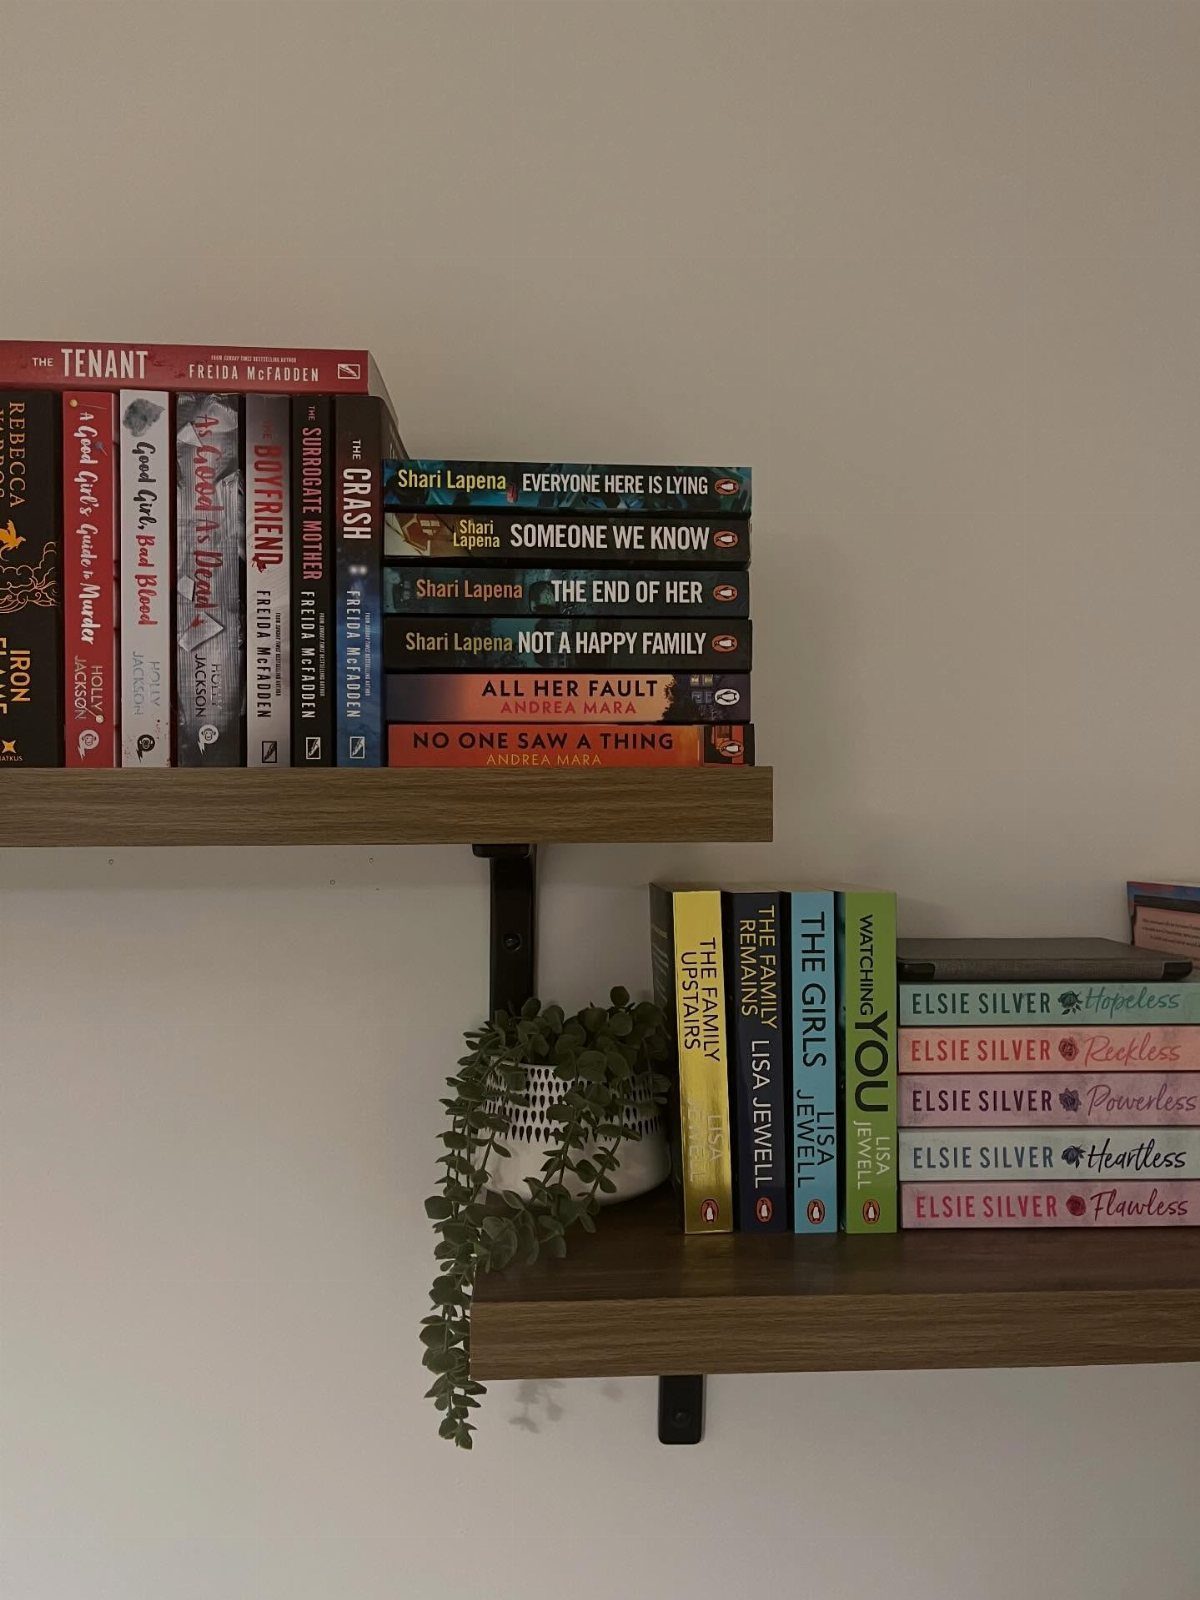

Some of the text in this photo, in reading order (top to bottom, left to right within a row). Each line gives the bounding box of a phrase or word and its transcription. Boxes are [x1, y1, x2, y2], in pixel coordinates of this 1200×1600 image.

[32, 348, 148, 379] THE TENANT
[189, 364, 319, 382] FREIDA McFADDEN
[9, 402, 26, 508] REBECCA
[253, 419, 284, 567] THE BOYFRIEND
[302, 405, 323, 580] THE SURROGATE MOTHER
[342, 439, 372, 539] THE CRASH
[398, 469, 507, 493] Shari Lapena
[522, 473, 709, 495] EVERYONE HERE IS LYING
[73, 411, 101, 645] A Good Girl's Guide to Murder
[132, 441, 158, 626] Good Girl, Bad Blood
[193, 414, 225, 609] As Good As Dead
[459, 519, 494, 535] Shari
[453, 533, 500, 551] Lapena
[510, 524, 710, 551] SOMEONE WE KNOW
[416, 579, 523, 602] Shari Lapena
[551, 579, 703, 604] THE END OF HER
[256, 590, 272, 718] FREIDA McFADDEN
[300, 591, 316, 718] FREIDA McFADDEN
[346, 590, 361, 718] FREIDA McFADDEN
[405, 632, 513, 656] Shari Lapena
[518, 631, 707, 655] NOT A HAPPY FAMILY
[9, 650, 31, 702] IRON
[74, 655, 87, 720] JACKSON
[90, 665, 103, 712] HOLLY
[132, 651, 145, 716] JACKSON
[148, 661, 161, 707] HOLLY
[194, 653, 207, 718] JACKSON
[210, 663, 223, 710] HOLLY
[481, 680, 658, 698] ALL HER FAULT
[500, 701, 636, 715] ANDREA MARA
[413, 732, 674, 750] NO ONE SAW A THING
[486, 753, 602, 766] ANDREA MARA
[739, 919, 758, 1017] REMAINS
[758, 904, 777, 1030] THE FAMILY
[801, 911, 827, 1068] THE GIRLS
[680, 952, 701, 1051] UPSTAIRS
[699, 937, 720, 1063] THE FAMILY
[854, 914, 889, 1113] WATCHING YOU
[912, 986, 1181, 1019] ELSIE SILVER Hopeless
[911, 1031, 1182, 1068] ELSIE SILVER Reckless
[751, 1040, 773, 1189] LISA JEWELL
[912, 1082, 1198, 1117] ELSIE SILVER Powerless
[687, 1096, 705, 1182] JEWELL
[707, 1115, 723, 1161] LISA
[796, 1089, 815, 1189] JEWELL
[816, 1111, 835, 1166] LISA
[853, 1120, 871, 1190] JEWELL
[875, 1136, 891, 1176] LISA
[913, 1138, 1187, 1174] ELSIE SILVER Heartless
[915, 1188, 1189, 1222] ELSIE SILVER Flawless
